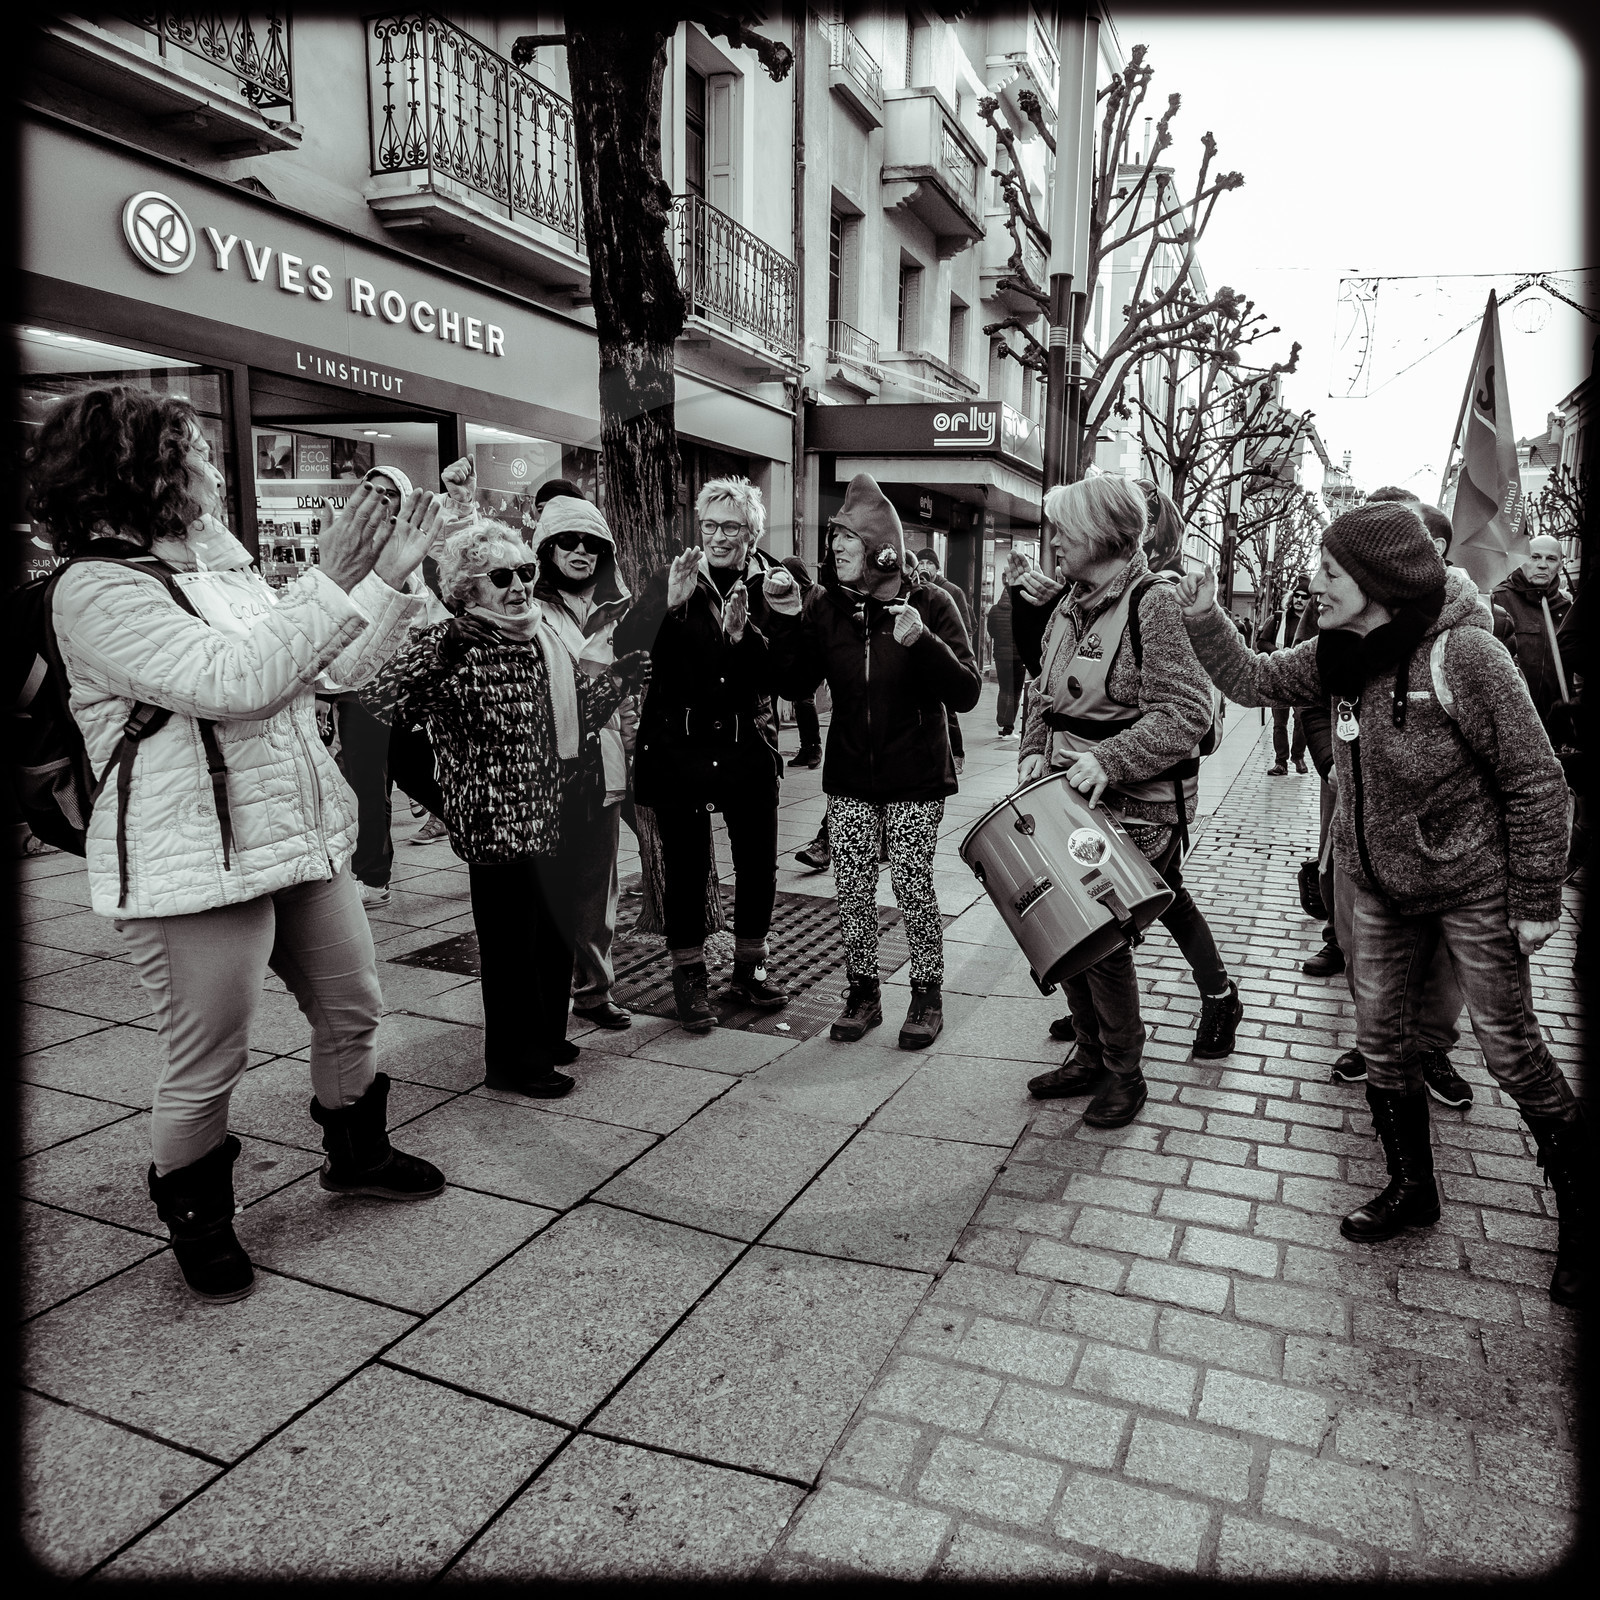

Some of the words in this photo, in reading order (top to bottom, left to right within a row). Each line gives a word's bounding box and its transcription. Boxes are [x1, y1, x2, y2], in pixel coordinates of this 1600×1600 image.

[202, 226, 334, 302] YVES
[350, 276, 506, 357] ROCHER
[295, 351, 404, 394] L'INSTITUT
[933, 406, 996, 447] orly
[300, 464, 330, 473] CONÇUS
[32, 559, 51, 567] SUR
[1015, 879, 1052, 914] Solidaires
